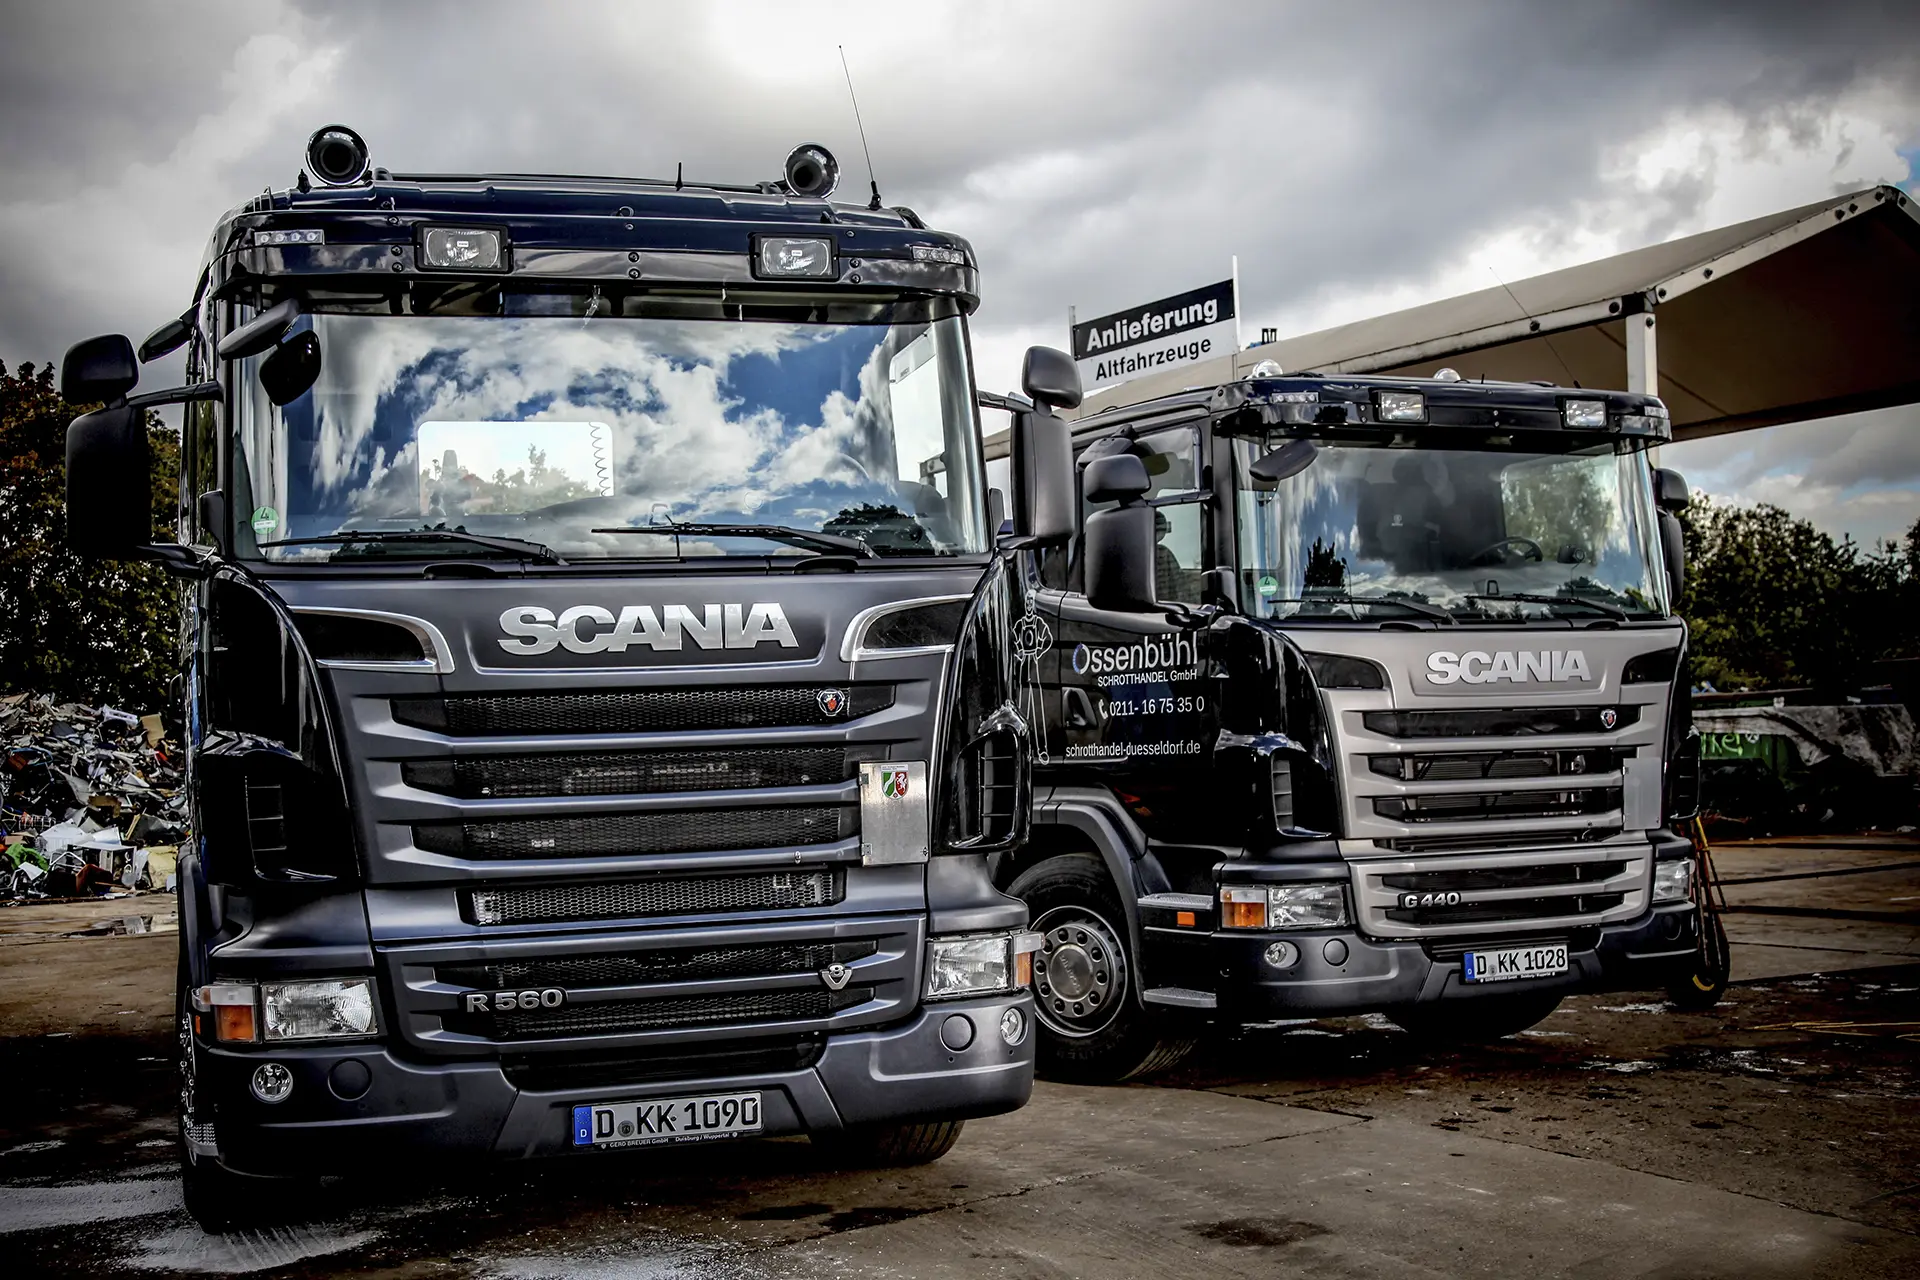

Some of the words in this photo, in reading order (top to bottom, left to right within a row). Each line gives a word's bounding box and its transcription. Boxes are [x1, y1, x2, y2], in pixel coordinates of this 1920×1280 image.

[1086, 298, 1218, 352] Anlieferung
[1096, 338, 1211, 381] Altfahrzeuge
[497, 602, 799, 655] SCANIA
[1072, 631, 1198, 675] Ossenbühl
[1098, 672, 1168, 687] SCHROTTHANDEL
[1170, 669, 1198, 682] GmbH
[1425, 650, 1592, 685] SCANIA
[1109, 701, 1138, 716] 0211-
[1142, 699, 1156, 715] 16
[1159, 698, 1174, 714] 75
[1177, 697, 1192, 713] 35
[1196, 696, 1205, 712] 0
[1065, 740, 1201, 757] schrotthandel-duesseldorf.de
[1404, 895, 1418, 908] G
[1420, 892, 1460, 907] 440
[1475, 956, 1487, 975] D
[1498, 952, 1520, 973] KK
[1524, 948, 1566, 971] 1028
[466, 994, 489, 1012] R
[495, 989, 563, 1011] 560
[595, 1109, 615, 1139] D
[636, 1103, 676, 1135] KK
[684, 1097, 758, 1131] 1090
[580, 1129, 588, 1138] D
